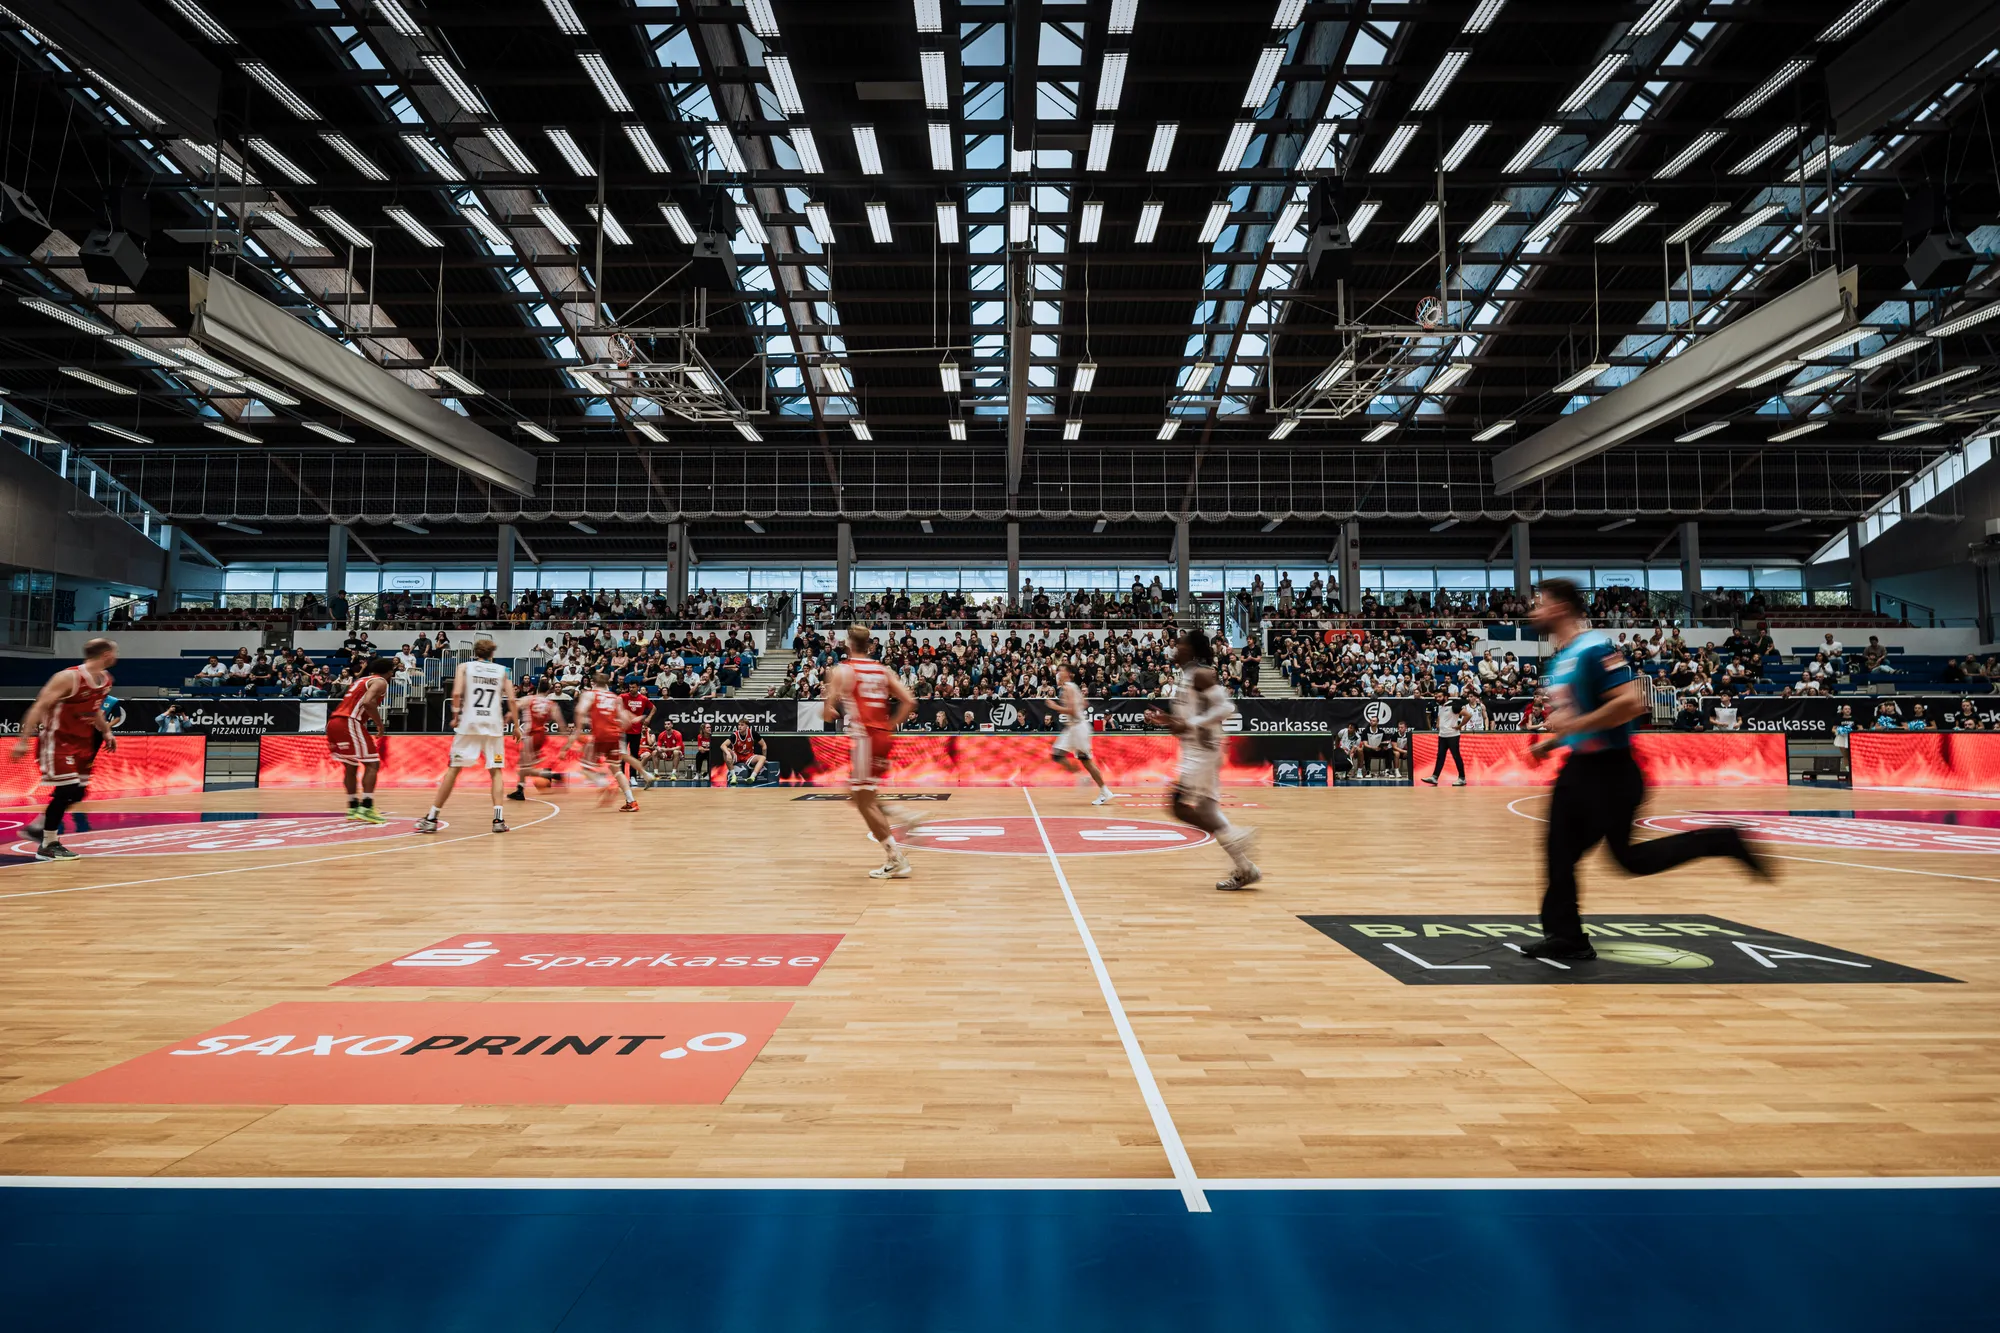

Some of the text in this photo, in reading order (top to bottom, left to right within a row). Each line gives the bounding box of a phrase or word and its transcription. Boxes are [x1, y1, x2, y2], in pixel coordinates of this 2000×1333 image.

[473, 687, 496, 708] 27
[668, 706, 777, 724] stückwerk
[1747, 716, 1827, 731] Sparkasse
[211, 727, 267, 735] PIZZAKULTUR
[1249, 717, 1329, 732] Sparkasse
[502, 952, 820, 971] Sparkasse
[168, 1034, 666, 1057] SAXOPRINT
